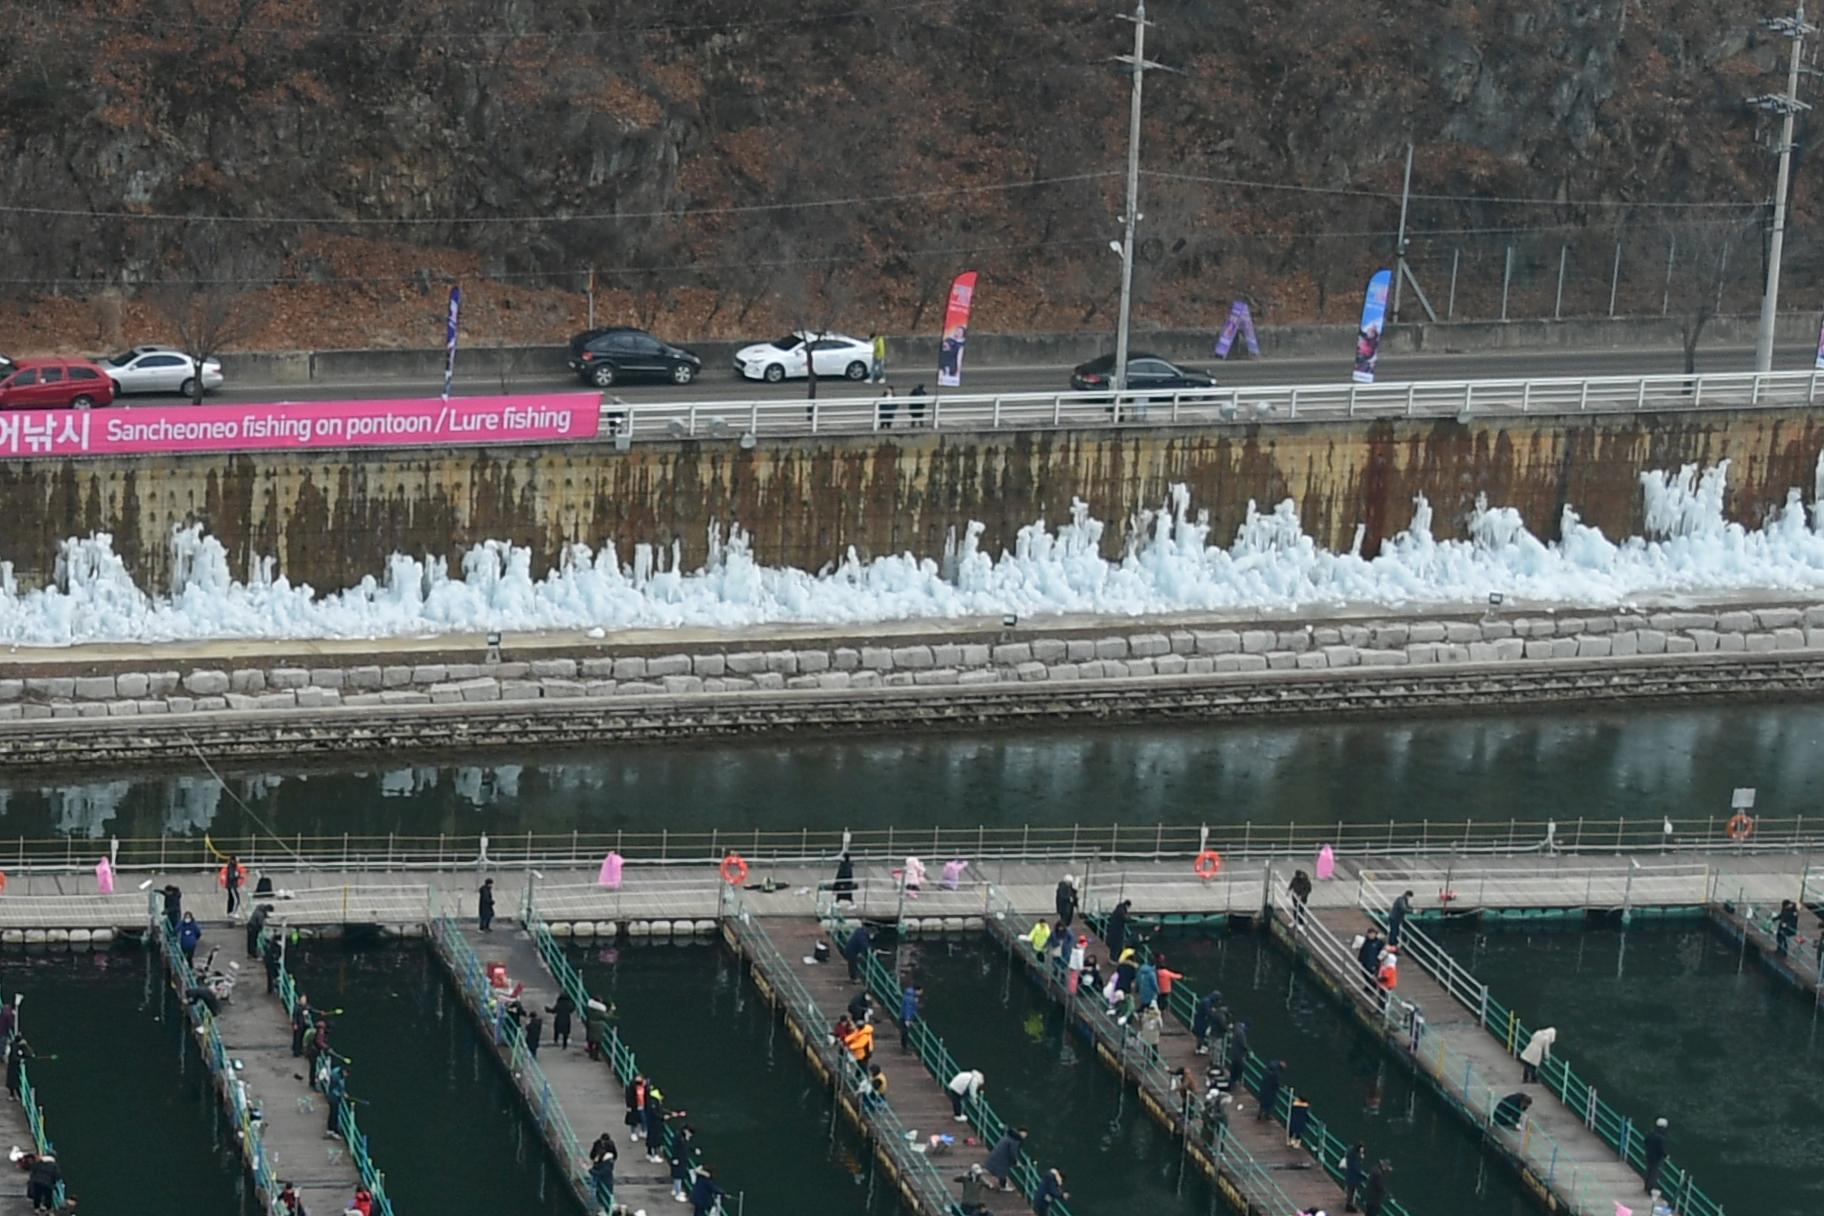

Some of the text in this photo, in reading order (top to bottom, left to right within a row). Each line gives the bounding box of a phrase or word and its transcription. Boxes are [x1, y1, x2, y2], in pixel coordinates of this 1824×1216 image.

[107, 418, 237, 441] Sancheoneo
[243, 416, 311, 442] fishing
[316, 420, 339, 435] on
[346, 413, 432, 442] pontoon
[449, 409, 498, 431] Lure
[503, 408, 571, 434] fishing
